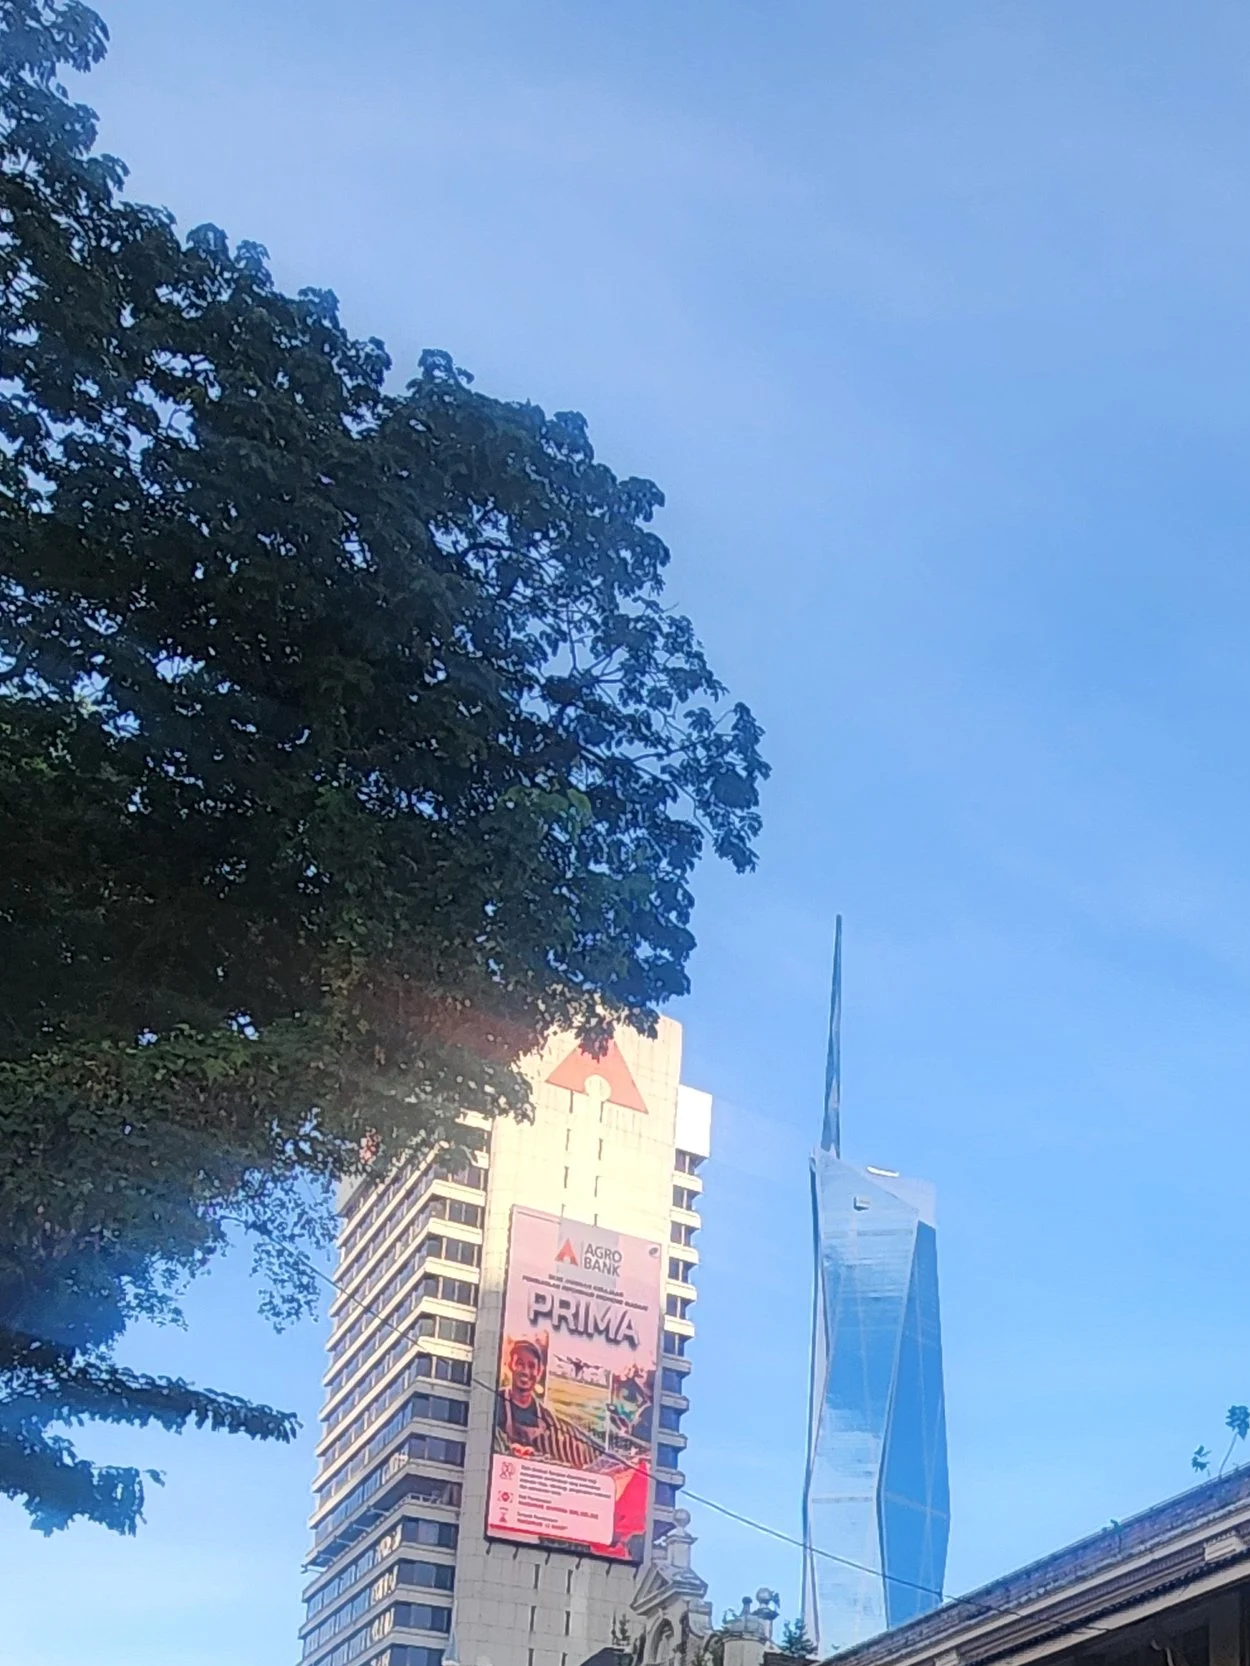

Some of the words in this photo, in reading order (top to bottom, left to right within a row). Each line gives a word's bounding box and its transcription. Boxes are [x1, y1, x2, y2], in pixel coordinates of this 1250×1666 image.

[584, 1243, 622, 1263] AGRO
[584, 1256, 620, 1277] BANK
[528, 1289, 640, 1348] PRIMA
